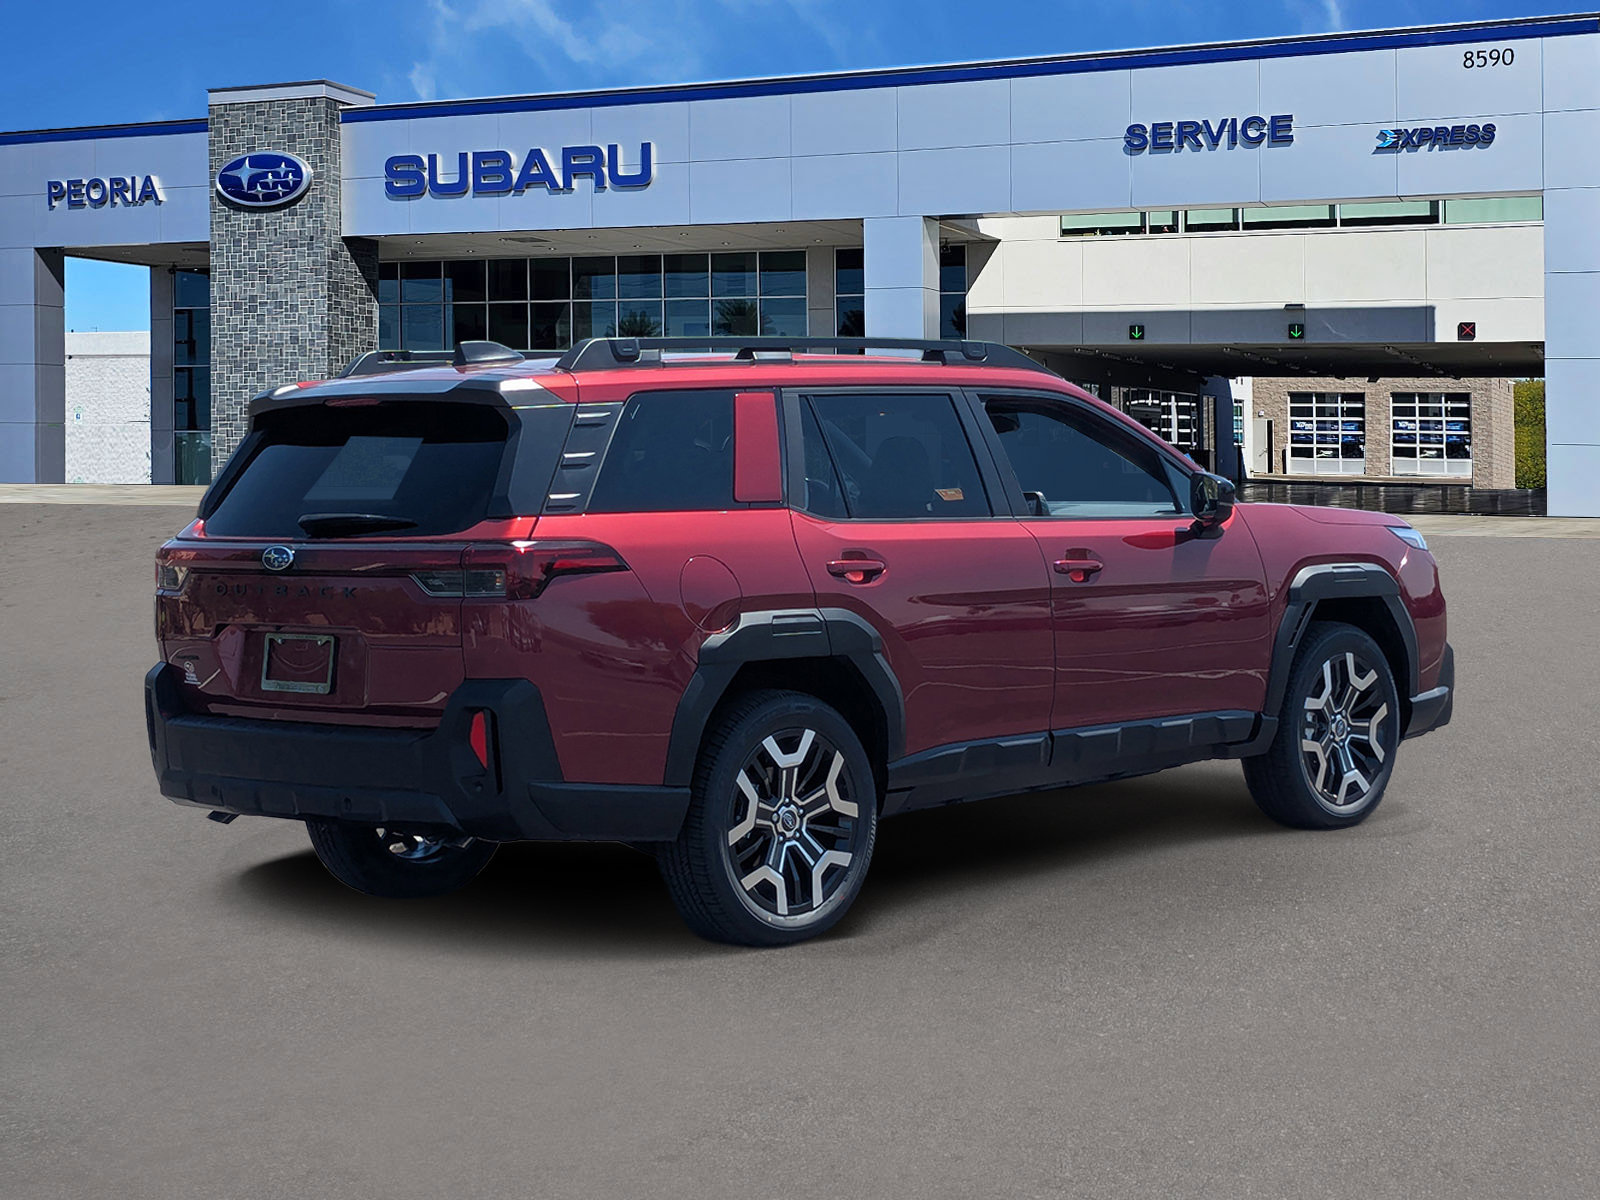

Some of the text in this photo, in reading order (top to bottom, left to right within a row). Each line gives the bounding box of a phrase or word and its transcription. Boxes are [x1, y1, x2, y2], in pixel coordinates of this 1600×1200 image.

[1463, 48, 1515, 69] 8590
[1125, 114, 1294, 152] SERVICE
[1376, 123, 1497, 149] EXPRESS
[384, 142, 653, 197] SUBARU
[47, 175, 162, 208] PEORIA
[216, 582, 358, 598] OUTBACK
